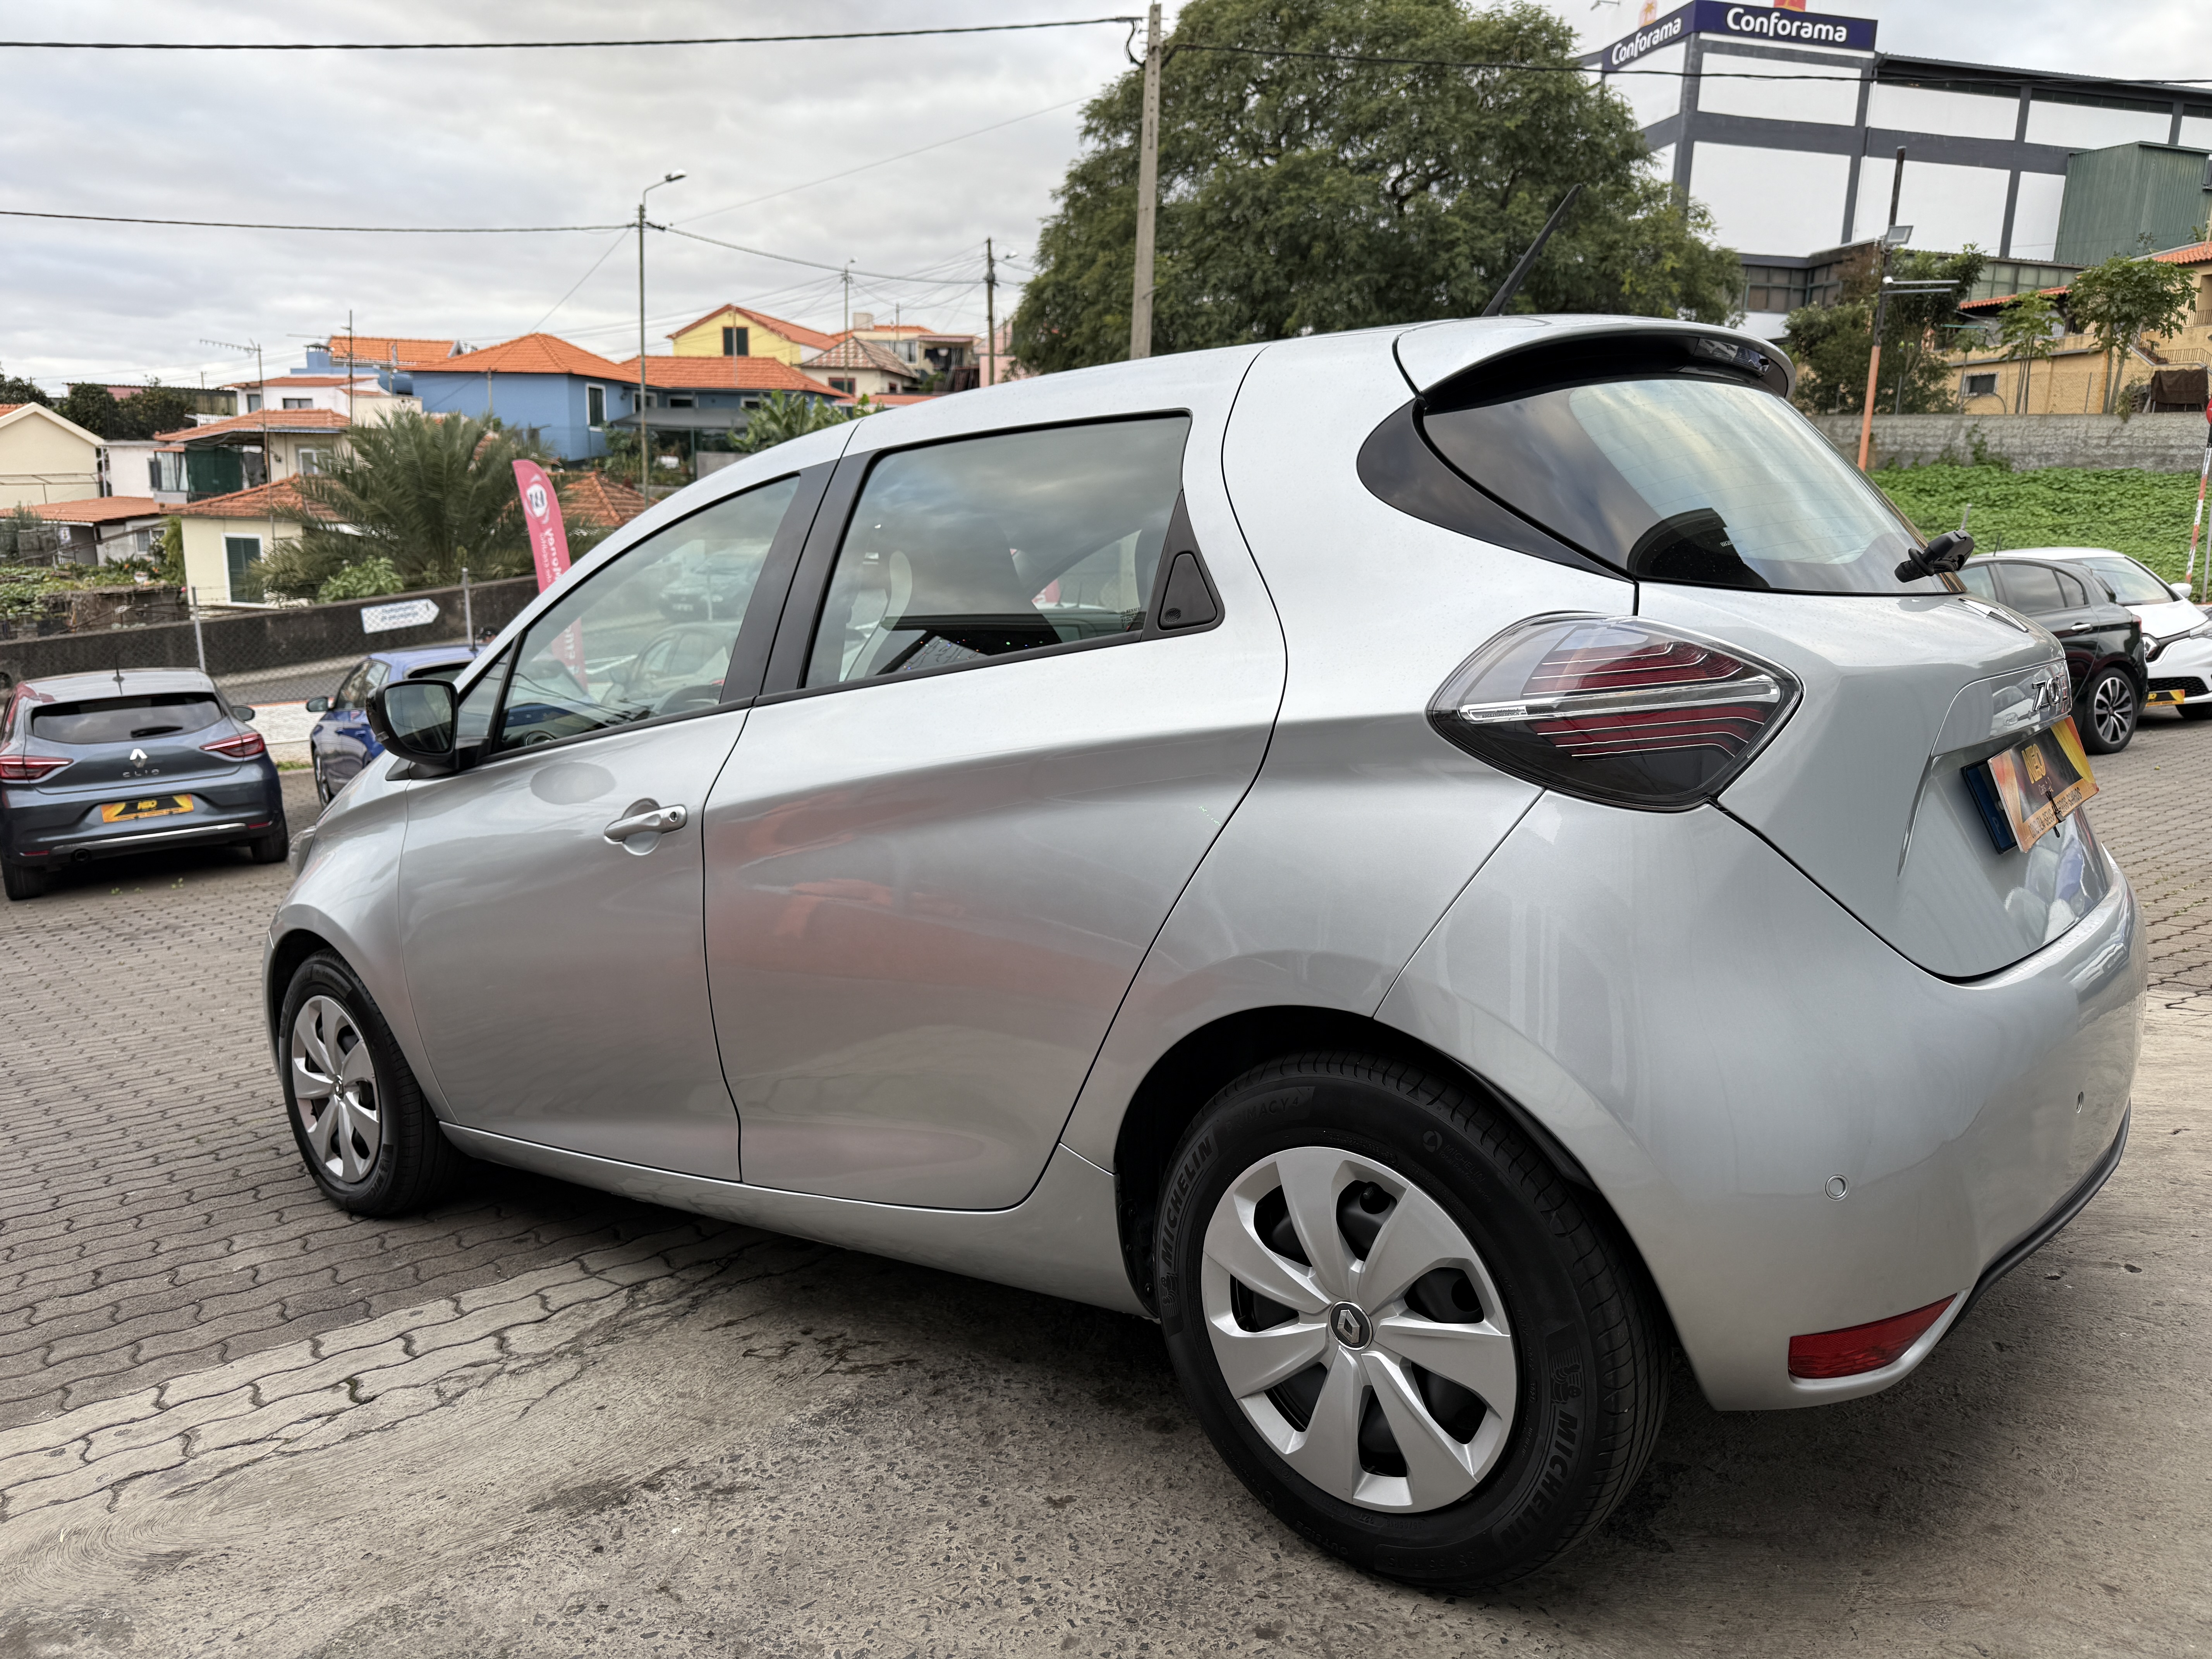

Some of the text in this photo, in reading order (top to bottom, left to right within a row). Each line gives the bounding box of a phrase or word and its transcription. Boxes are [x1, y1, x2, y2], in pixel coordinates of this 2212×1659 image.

[1611, 17, 1681, 65] Conforama
[1726, 7, 1848, 42] Conforama
[2021, 744, 2046, 784] NEO
[1293, 1097, 1300, 1107] 4
[1444, 1144, 1486, 1182] MICHELIN
[1161, 1135, 1213, 1267] MICHELIN
